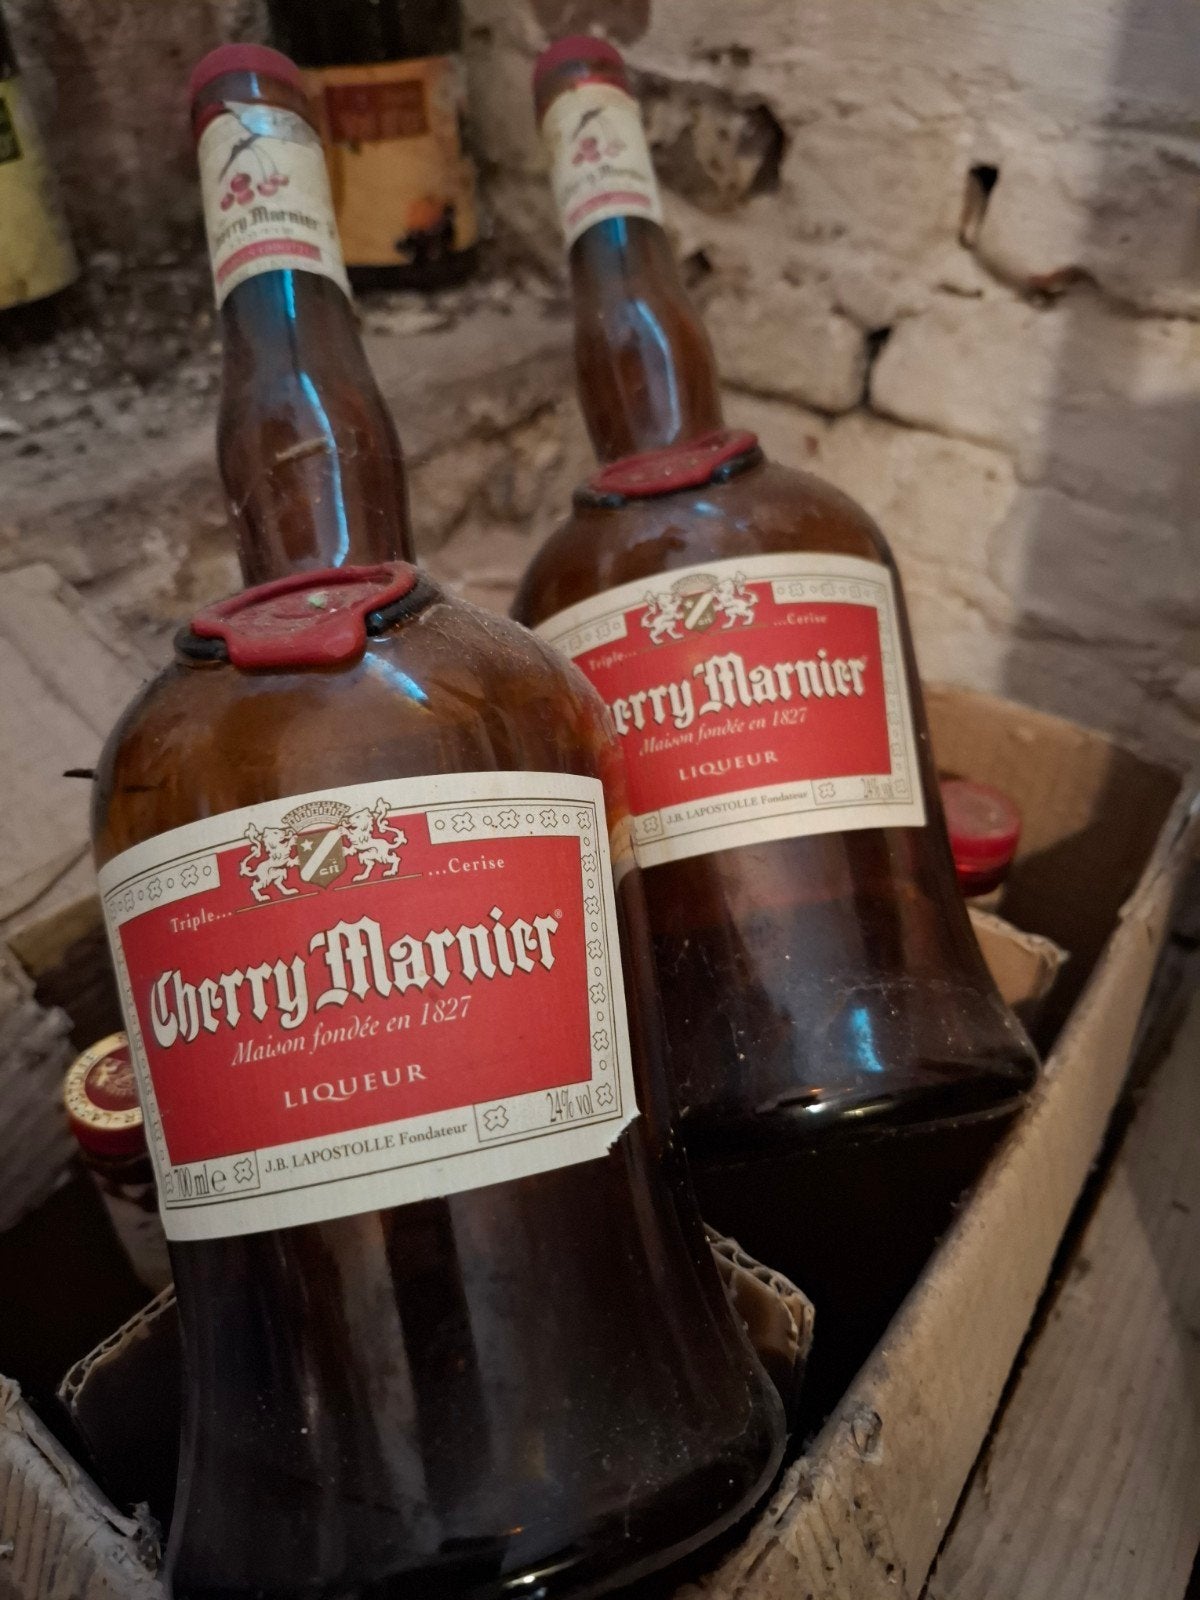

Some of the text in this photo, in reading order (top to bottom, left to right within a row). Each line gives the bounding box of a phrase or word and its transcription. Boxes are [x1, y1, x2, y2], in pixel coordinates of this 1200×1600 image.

[639, 732, 695, 756] Maison
[747, 716, 767, 730] en
[771, 707, 808, 727] 1827
[679, 750, 778, 781] LIQUEUR
[686, 797, 759, 822] LAPOSTOLLE
[761, 790, 808, 806] Fondateur
[150, 954, 309, 1048] Cherry
[231, 995, 473, 1066] Maison fondée en 1827
[283, 1063, 427, 1109] LIQUEUR
[546, 1084, 596, 1123] 24% vol
[265, 1122, 468, 1174] J.B. LAPOSTOLLE Fondateur
